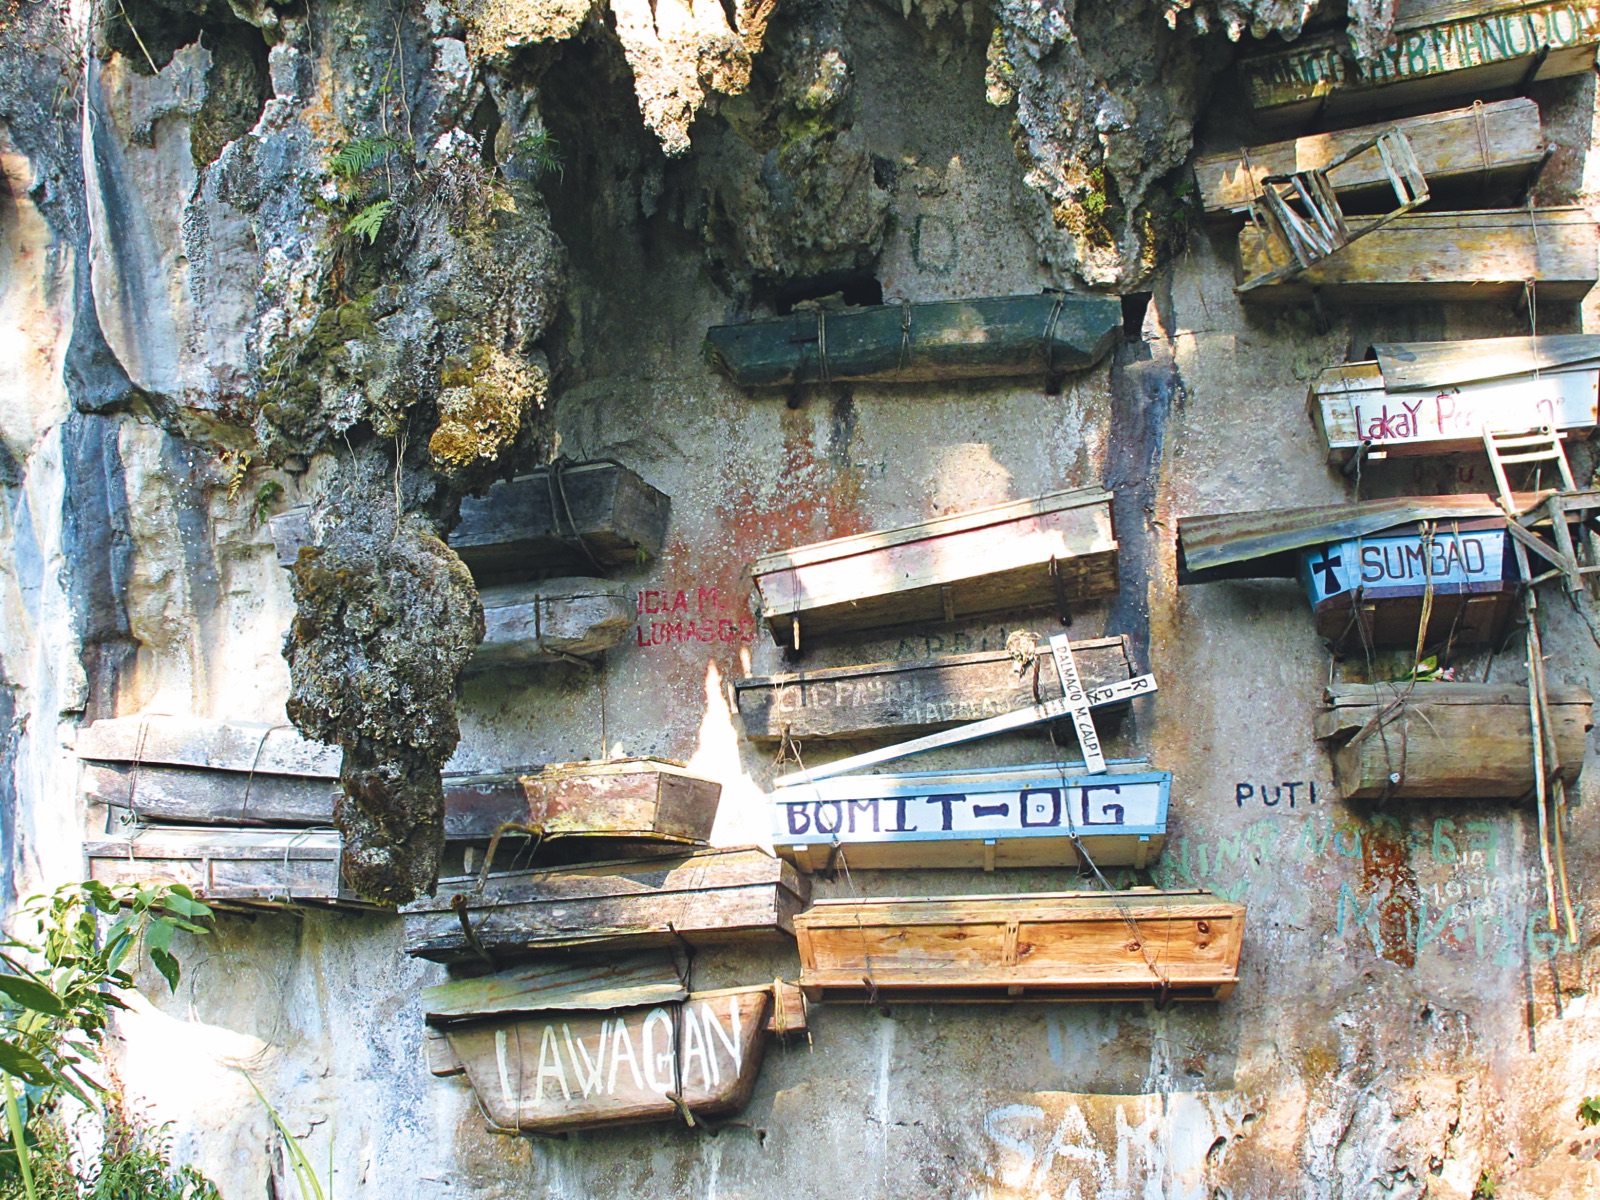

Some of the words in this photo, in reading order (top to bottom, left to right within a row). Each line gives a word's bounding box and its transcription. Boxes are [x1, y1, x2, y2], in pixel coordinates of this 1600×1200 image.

[1361, 538, 1485, 582] SUMBAD
[1055, 645, 1083, 702] DALMACIO
[1078, 722, 1100, 758] CALPI
[1236, 781, 1317, 808] PUTI
[495, 995, 742, 1109] LAWAGAN
